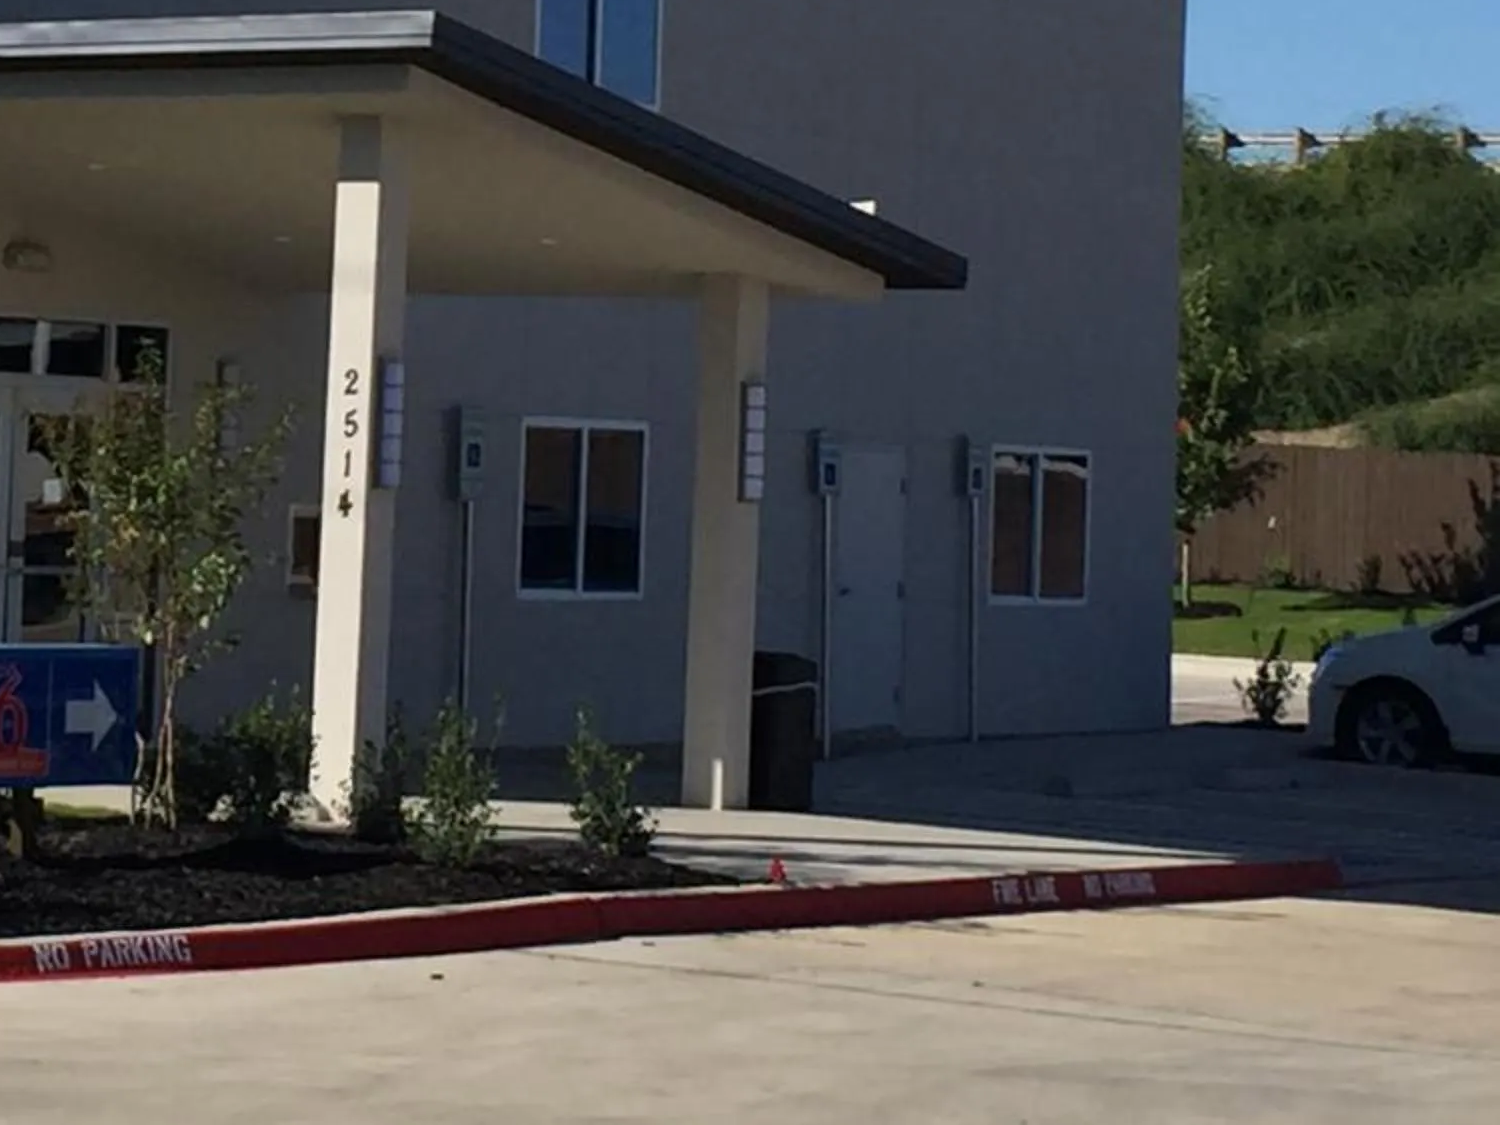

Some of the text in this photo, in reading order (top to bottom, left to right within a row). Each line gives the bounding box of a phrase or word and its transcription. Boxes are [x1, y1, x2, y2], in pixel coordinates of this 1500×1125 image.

[337, 368, 359, 518] 2514
[32, 941, 71, 973] NO
[81, 934, 192, 969] PARKING
